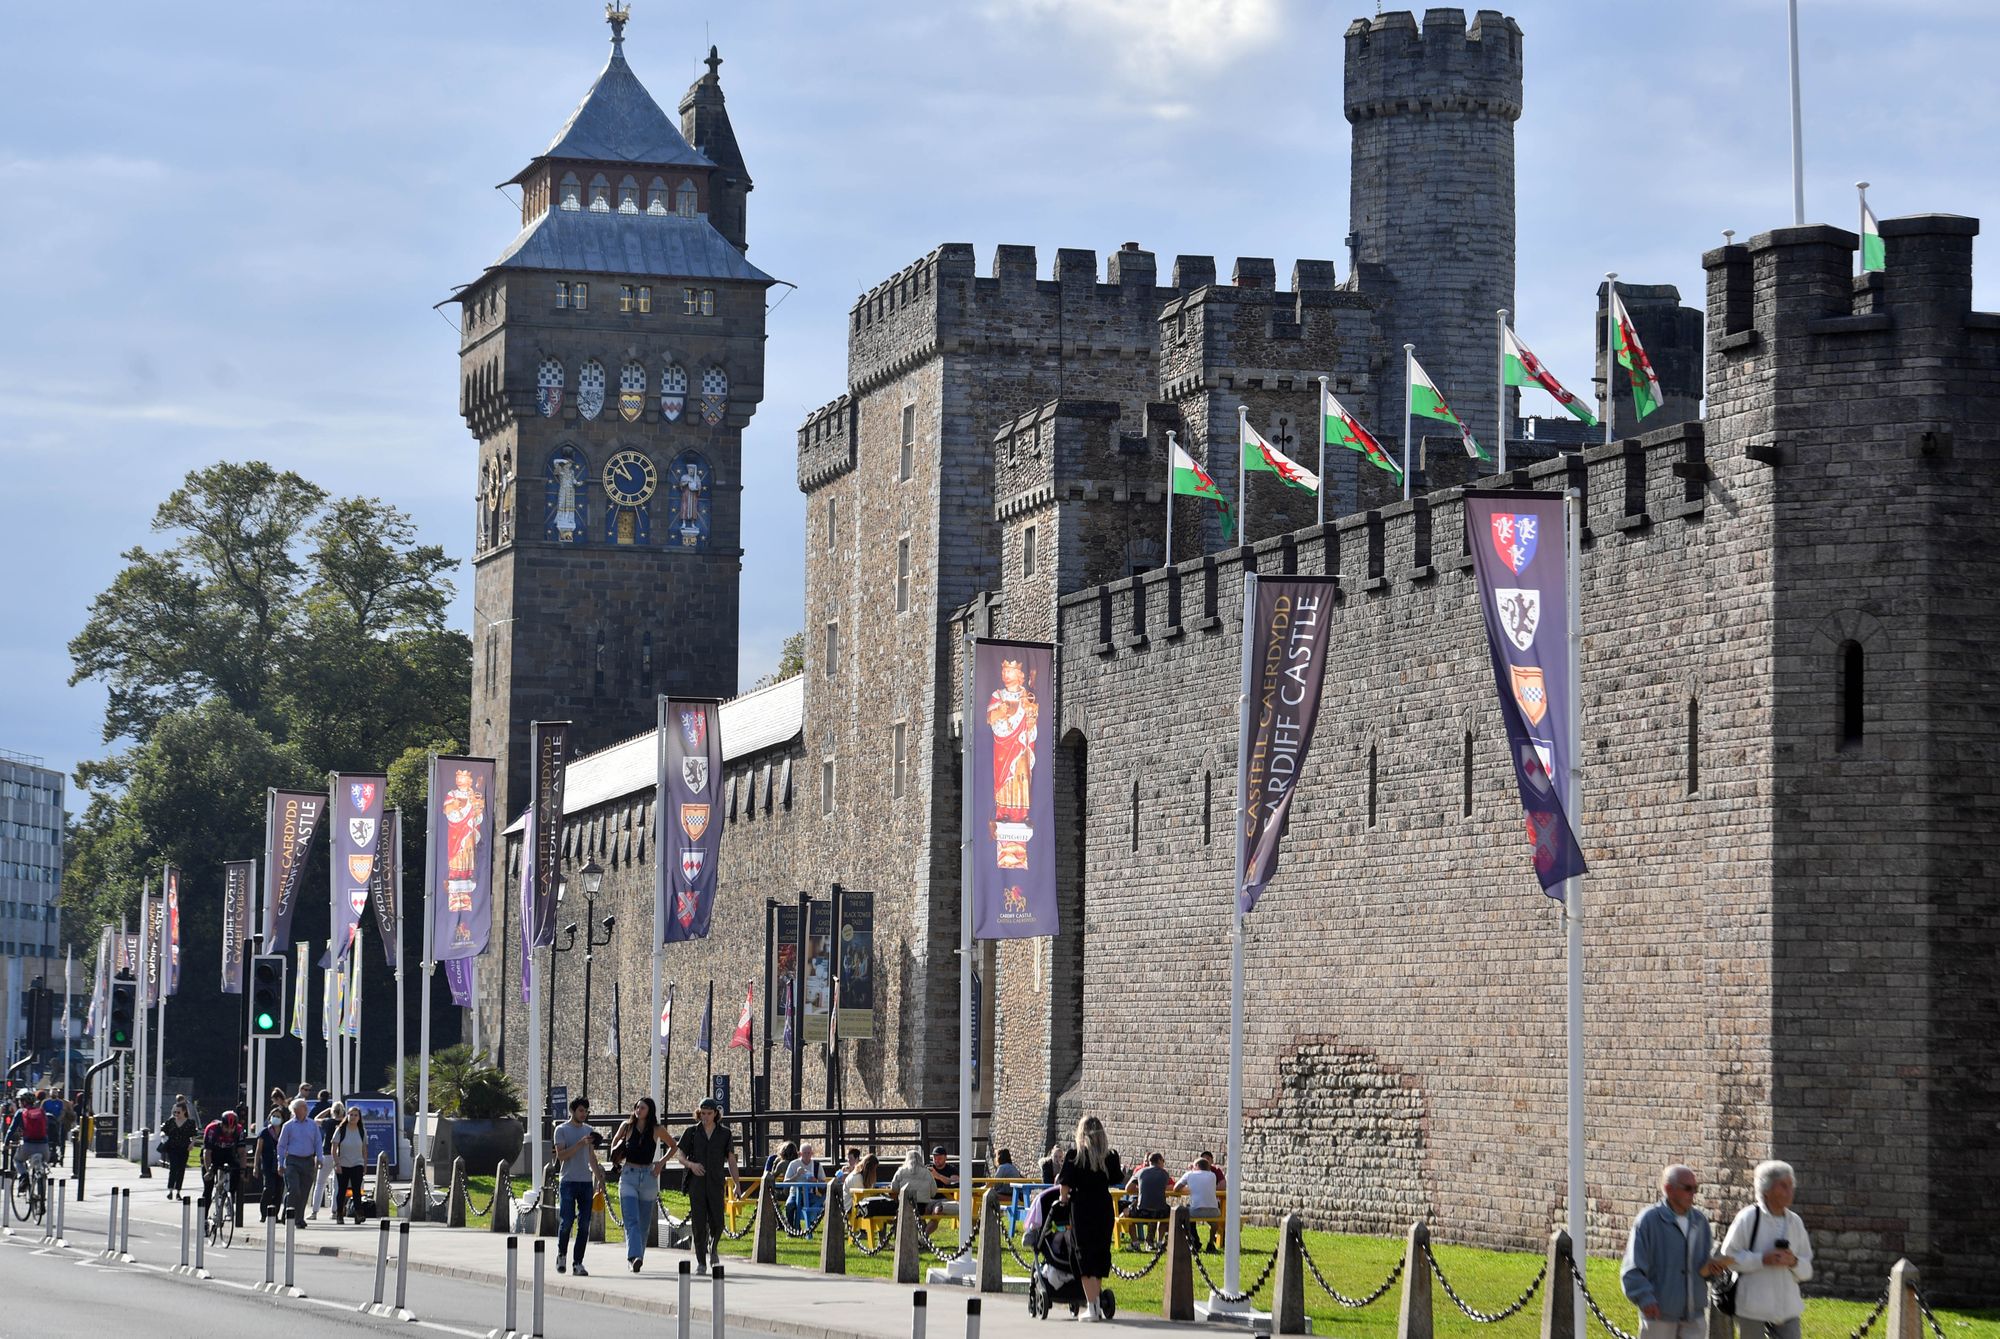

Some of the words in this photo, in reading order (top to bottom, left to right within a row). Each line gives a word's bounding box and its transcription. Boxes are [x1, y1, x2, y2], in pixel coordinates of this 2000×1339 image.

[1281, 595, 1319, 706] CASTLE
[1246, 729, 1269, 838] CASTELL
[1259, 595, 1291, 727] CAERDYDD
[540, 736, 552, 824] CAERDYDD
[281, 800, 298, 869] CAERDYDD
[296, 801, 316, 857] CASTLE
[540, 828, 549, 897] CASTELL
